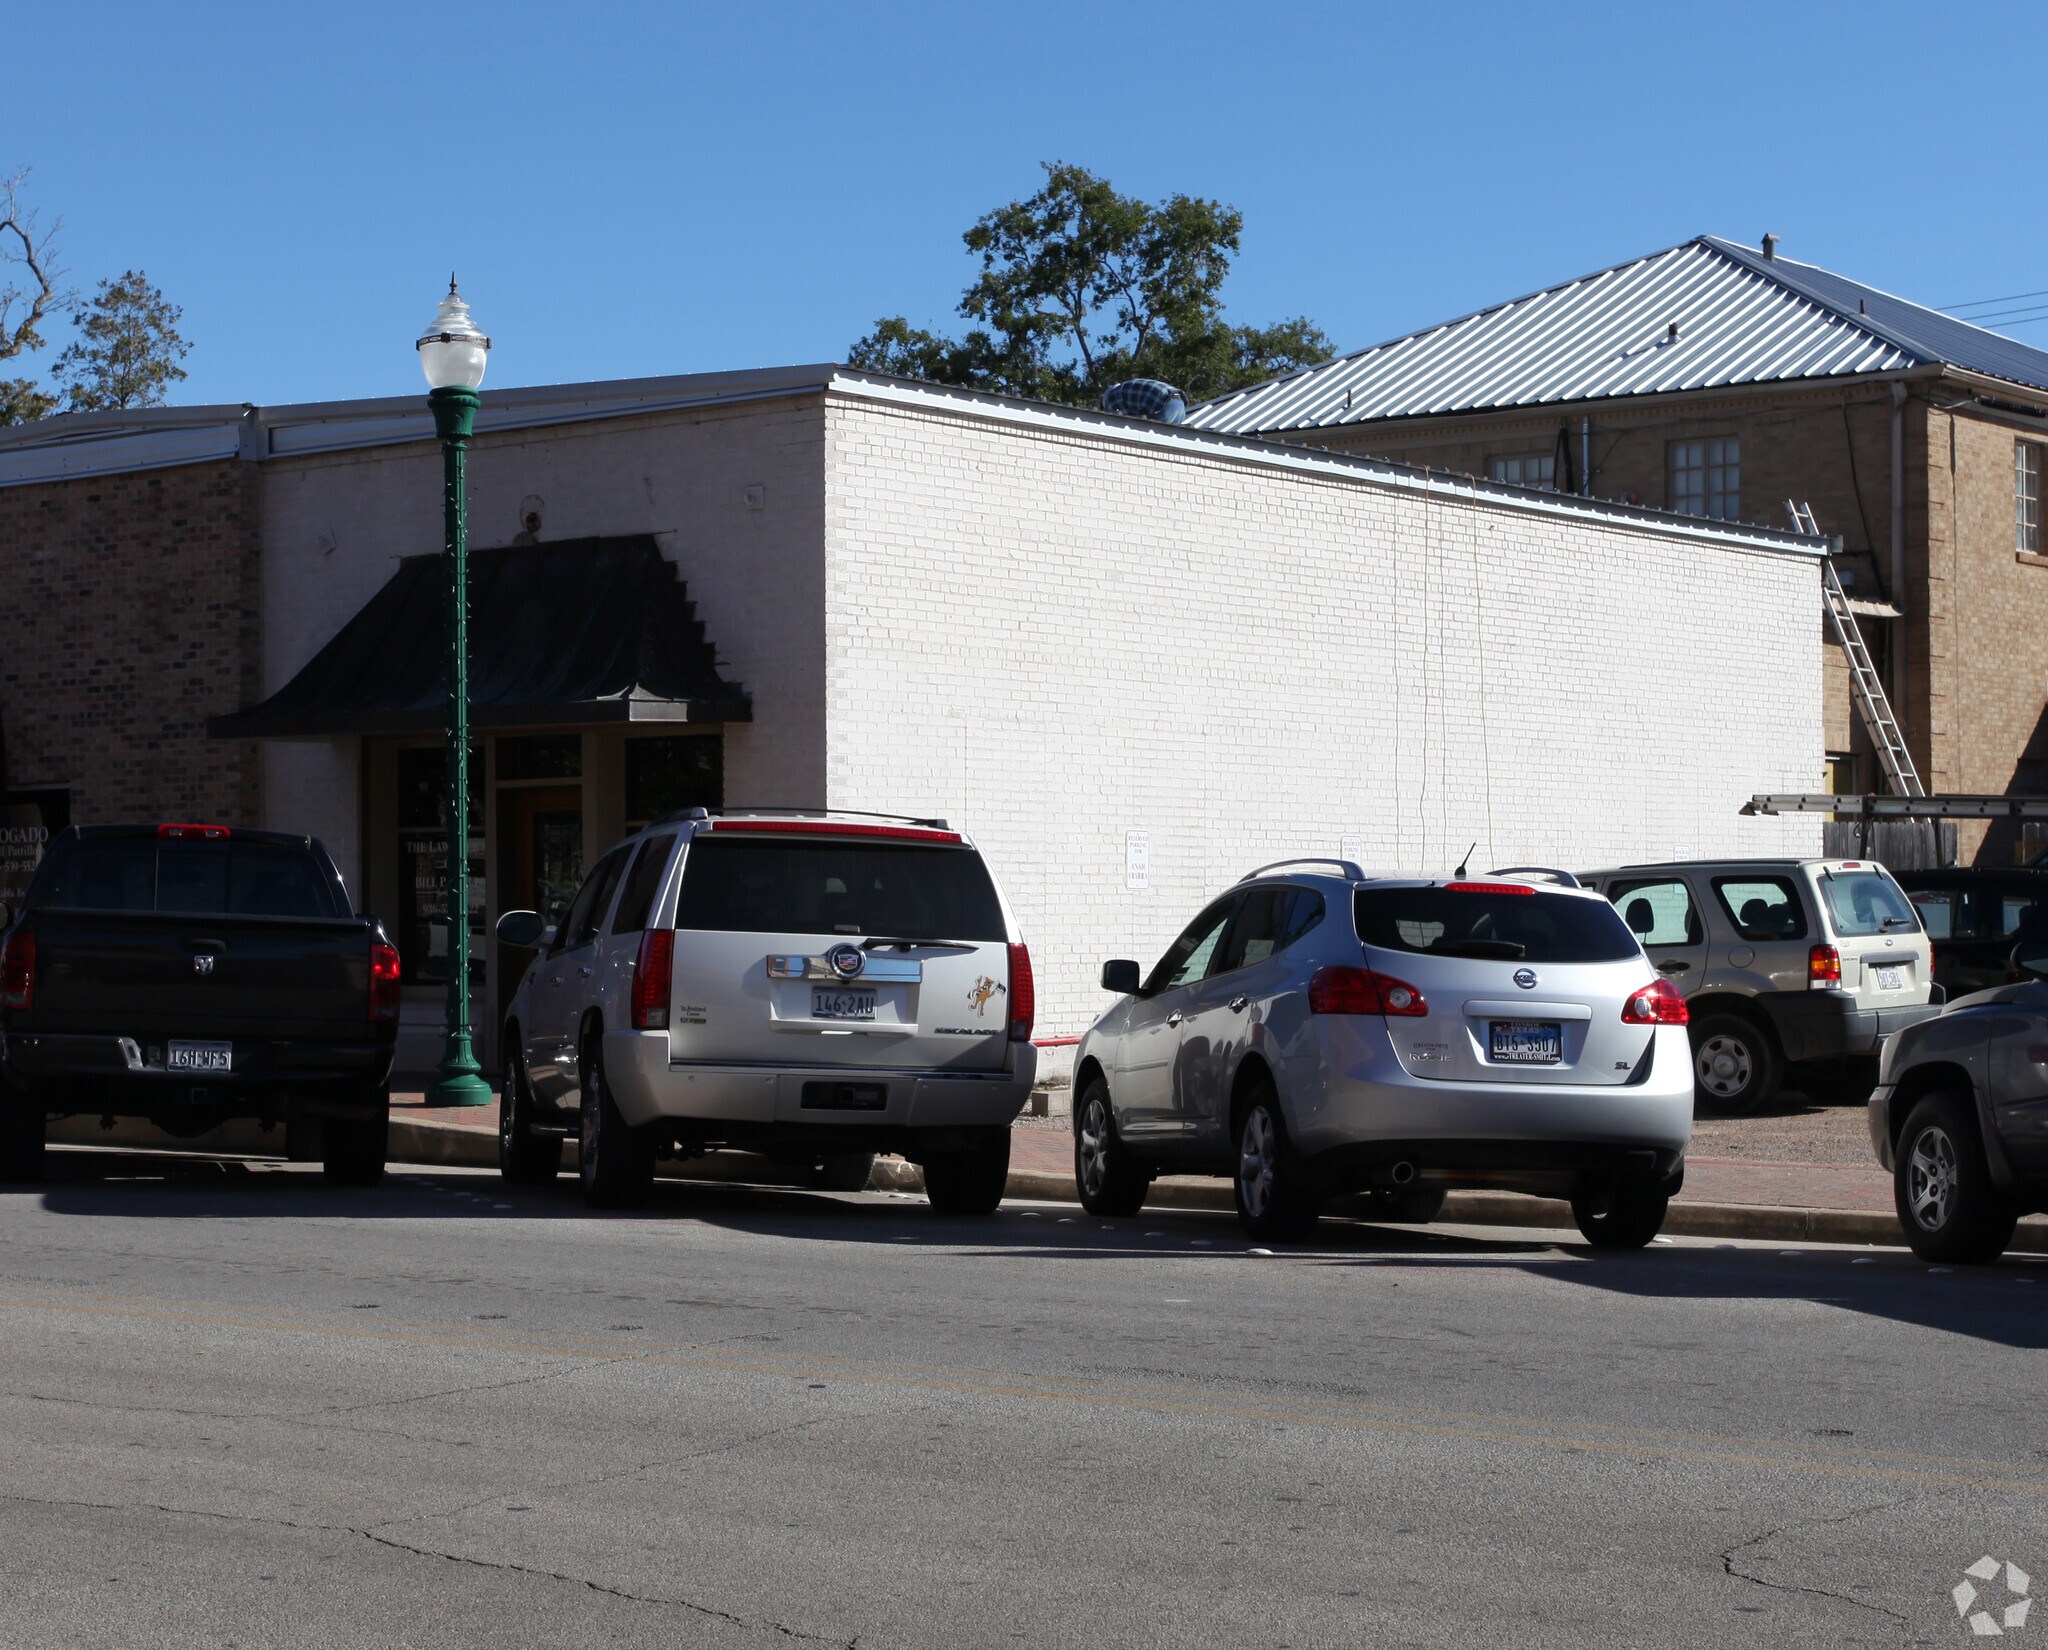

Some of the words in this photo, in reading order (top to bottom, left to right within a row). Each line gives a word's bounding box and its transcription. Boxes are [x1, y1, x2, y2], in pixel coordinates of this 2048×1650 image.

[406, 841, 428, 853] THE
[816, 995, 842, 1012] 146
[848, 996, 874, 1014] 2AU
[1510, 1026, 1540, 1034] TEXAS
[1497, 1034, 1518, 1052] BT5
[1615, 1061, 1631, 1070] SL
